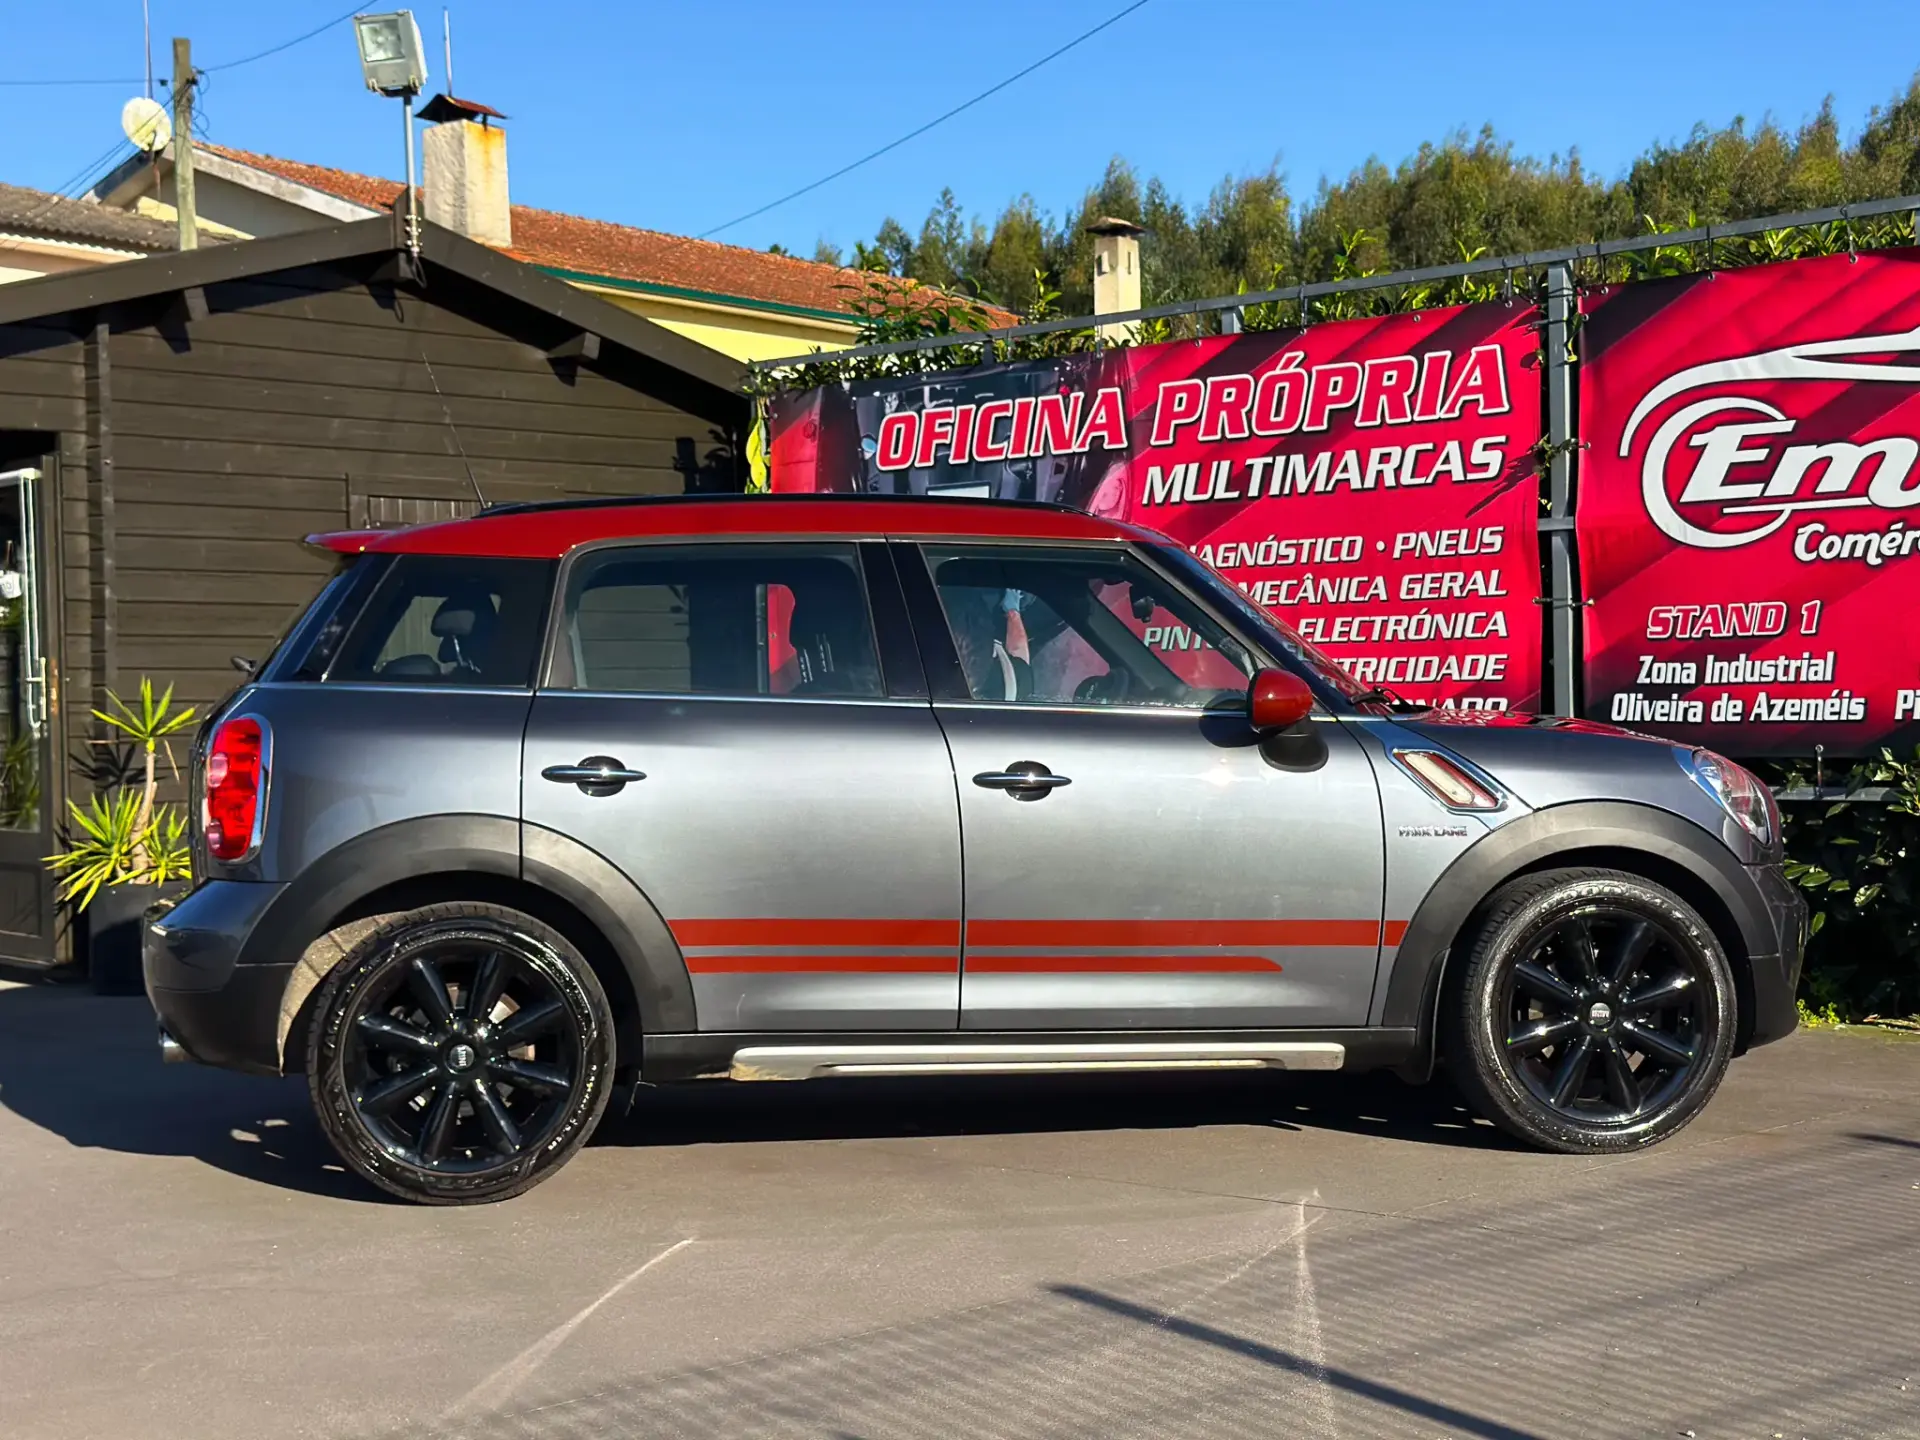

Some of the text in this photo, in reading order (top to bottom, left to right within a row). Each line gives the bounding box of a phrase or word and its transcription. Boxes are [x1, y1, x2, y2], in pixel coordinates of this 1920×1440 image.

[876, 343, 1511, 471] OFICINA PRÓPRIA
[1141, 435, 1507, 505] MULTIMARCAS
[1392, 526, 1504, 559] PNEUS
[1794, 522, 1920, 566] Comér
[1400, 569, 1508, 600] GERAL
[1297, 608, 1508, 643] ELECTRÓNICA
[1646, 600, 1821, 638] STAND 1
[1332, 654, 1507, 682] TRICIDADE
[1636, 651, 1835, 684] Zona Industrial
[1611, 689, 1866, 722] Oliveira de Azeméis
